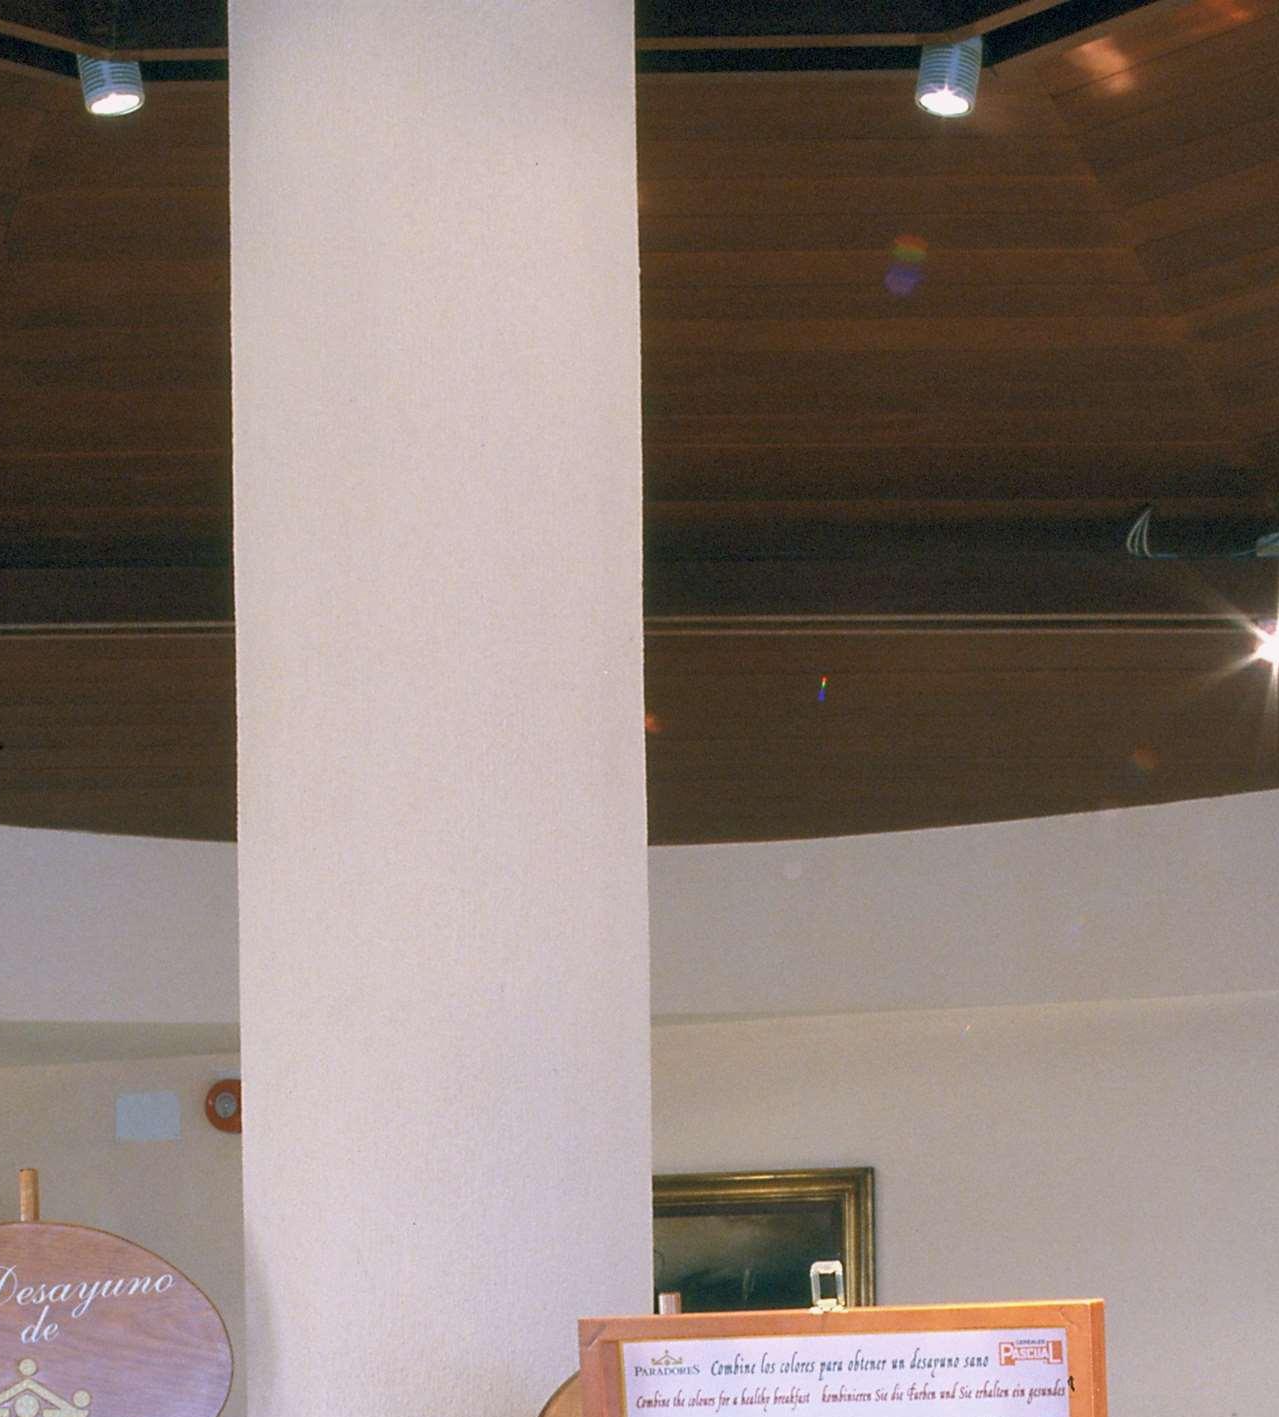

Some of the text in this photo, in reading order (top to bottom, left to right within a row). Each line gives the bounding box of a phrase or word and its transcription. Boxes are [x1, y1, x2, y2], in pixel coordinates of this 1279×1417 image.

[20, 1306, 59, 1344] de
[711, 1348, 989, 1381] Combine los colores para obtener un desayuno sano
[1000, 1341, 1062, 1365] PASCUAL
[635, 1365, 700, 1377] PARADORES
[636, 1390, 669, 1409] Combine
[673, 1389, 686, 1407] the
[688, 1389, 714, 1407] colours
[715, 1391, 729, 1413] for
[741, 1387, 770, 1413] healthy
[773, 1386, 810, 1410] breakfast
[875, 1388, 888, 1401] Sie
[891, 1384, 904, 1401] die
[906, 1382, 936, 1400] Farben
[940, 1382, 957, 1399] und
[959, 1386, 972, 1399] Sie
[975, 1380, 1009, 1399] erhalten
[1012, 1385, 1026, 1398] ein
[1028, 1379, 1065, 1404] gesundes
